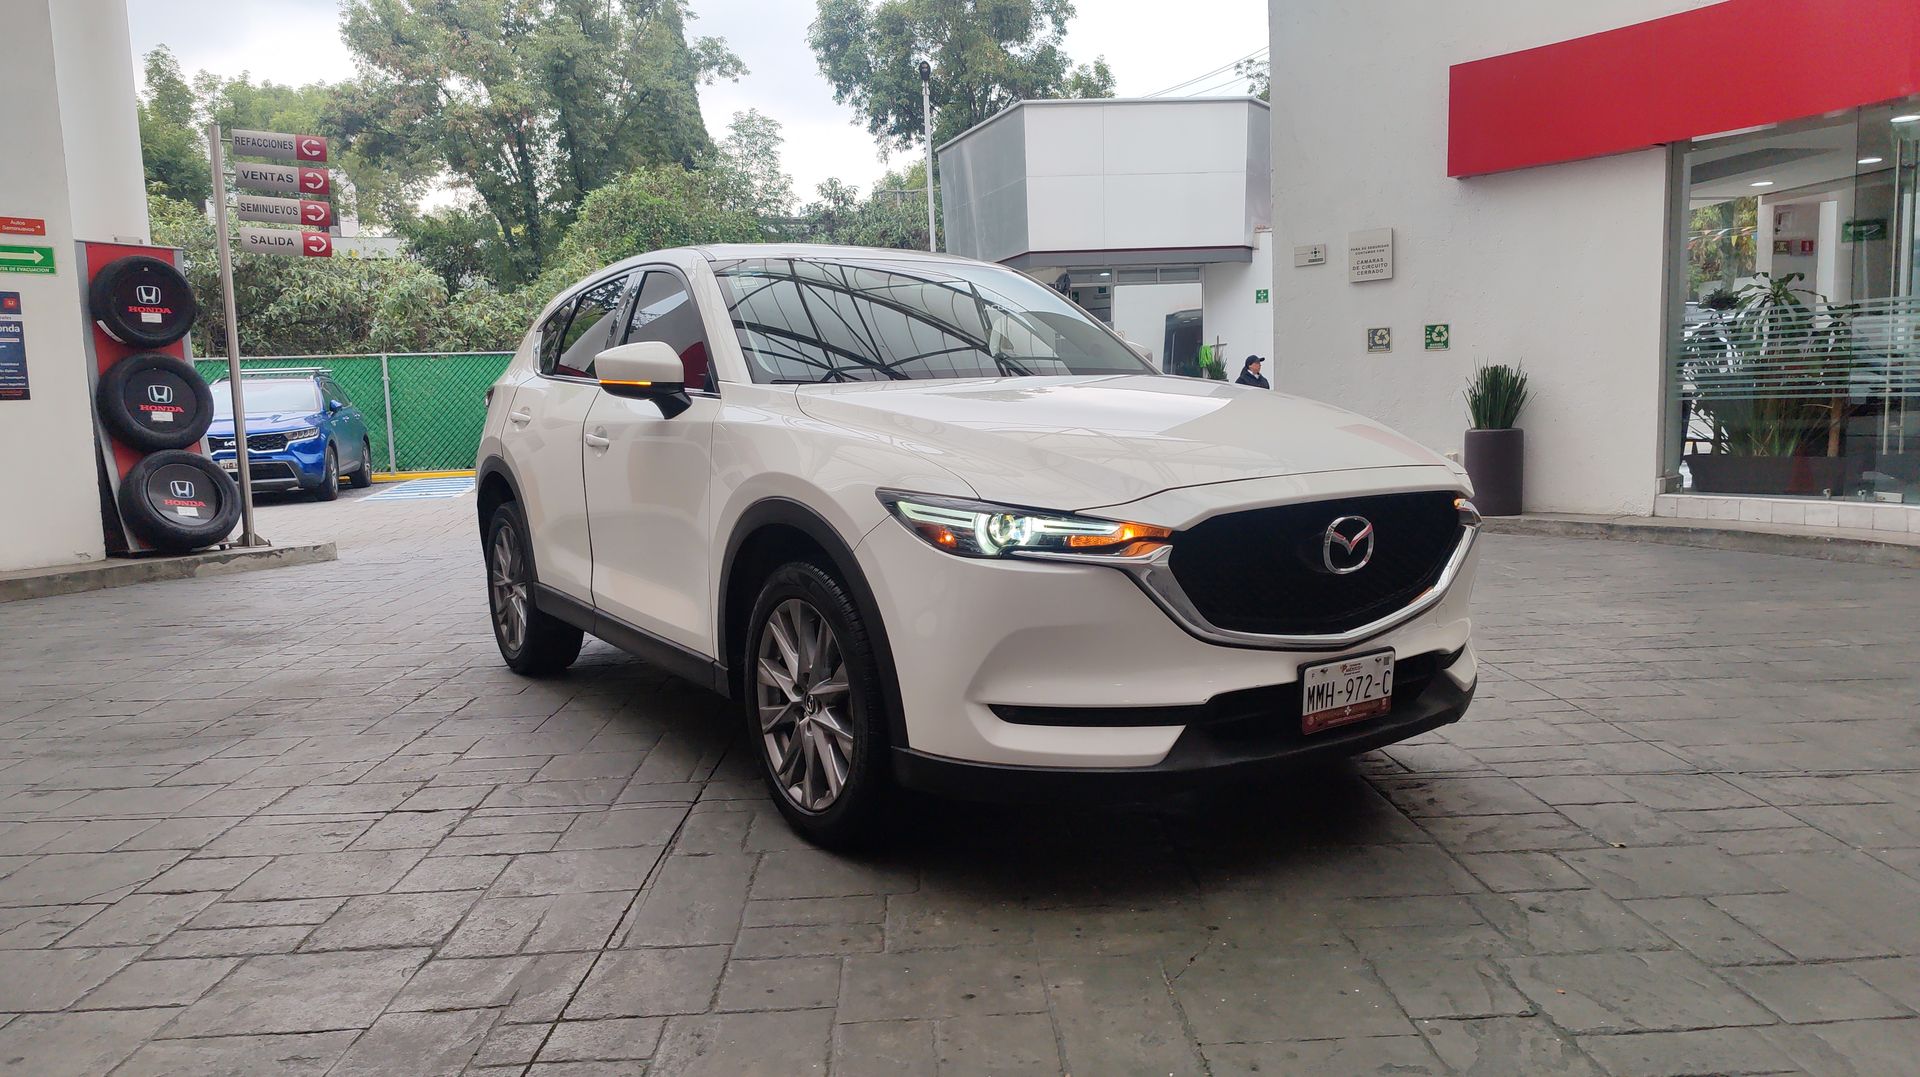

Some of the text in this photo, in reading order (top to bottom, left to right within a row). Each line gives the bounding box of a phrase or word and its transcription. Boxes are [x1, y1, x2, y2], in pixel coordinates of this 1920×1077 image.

[234, 136, 294, 150] REFACCIONES
[242, 170, 294, 183] VENTAS
[240, 202, 298, 216] SEMINUEVOS
[250, 234, 295, 247] SALIDA
[128, 305, 172, 314] HONDA
[0, 323, 21, 333] onda
[140, 404, 185, 414] HONDA
[164, 499, 206, 507] HONDA
[1307, 670, 1391, 713] MMH-972-C
